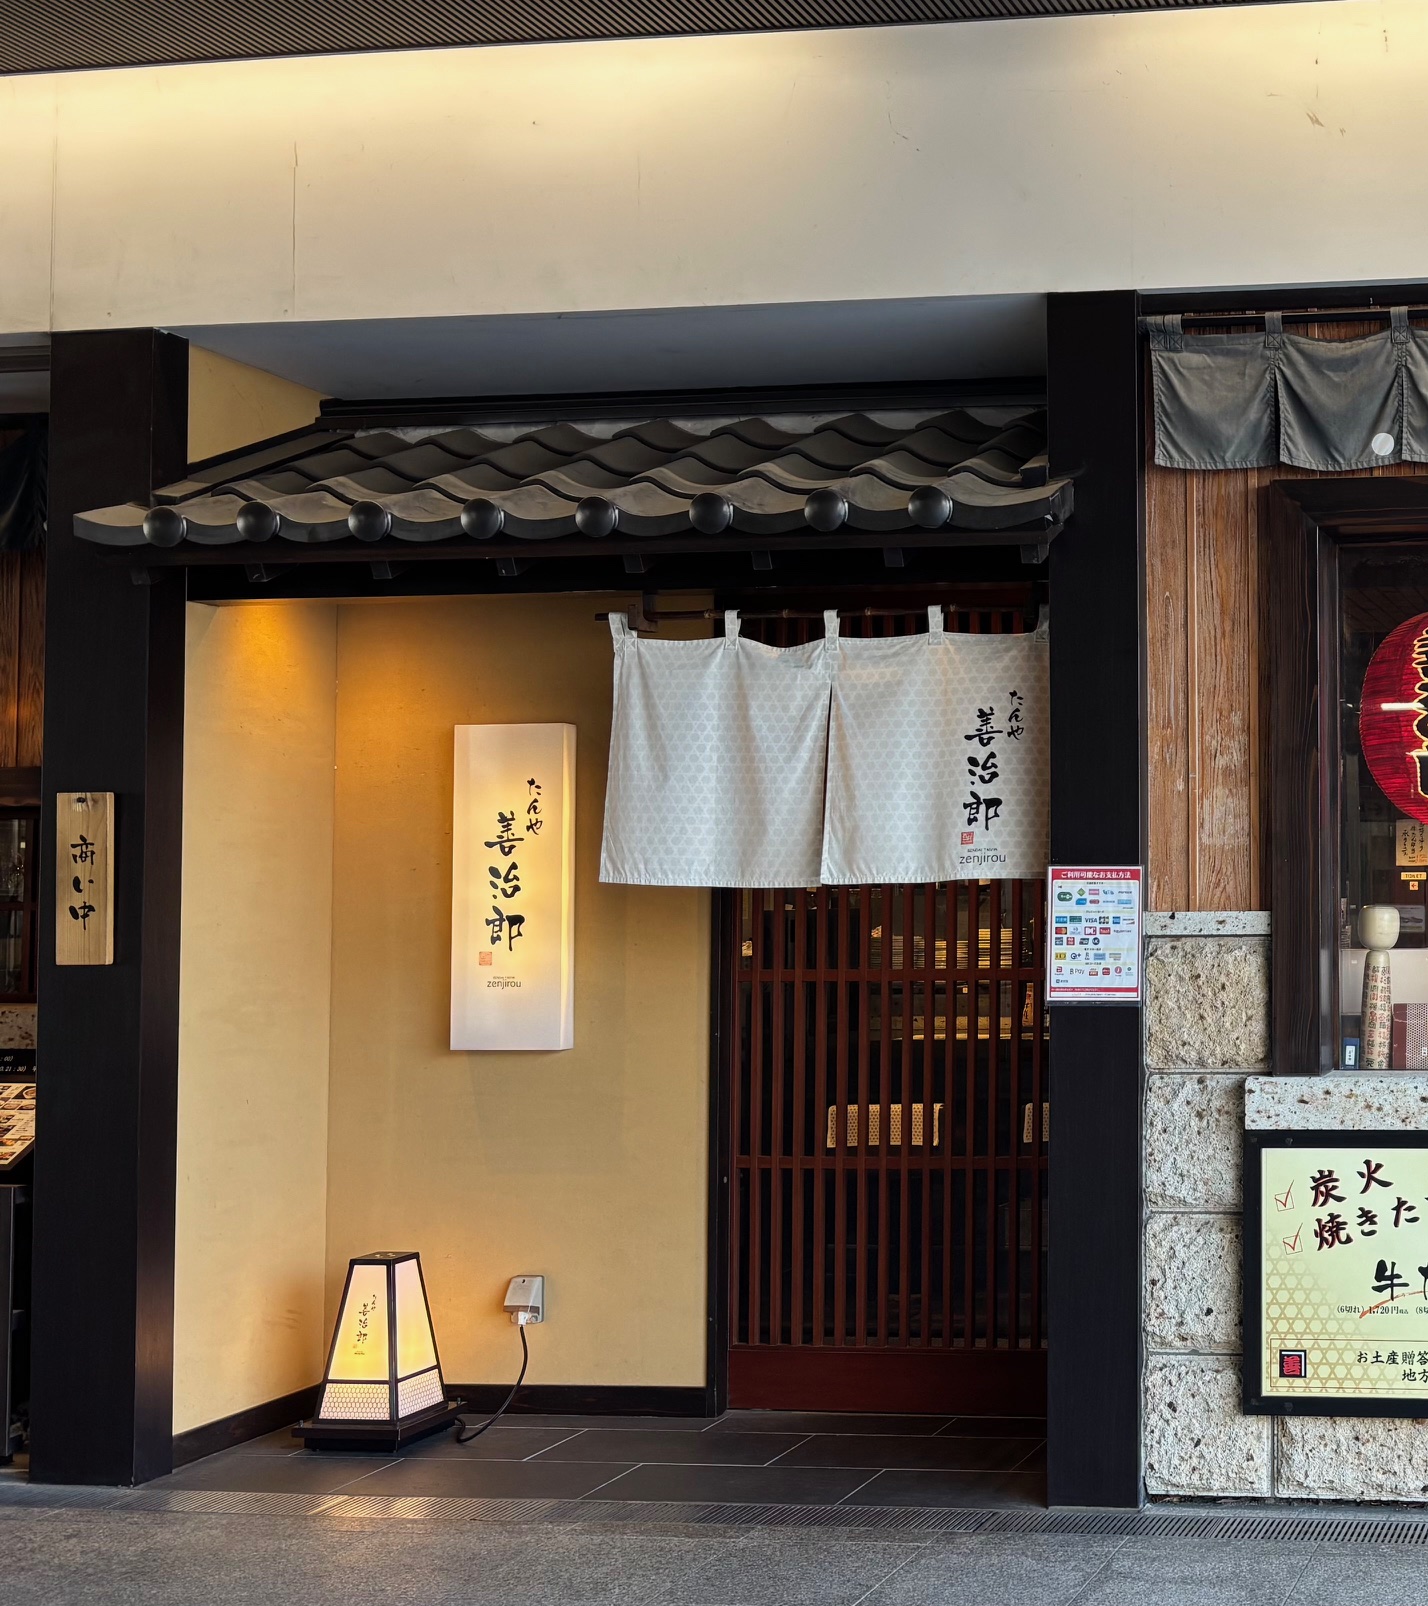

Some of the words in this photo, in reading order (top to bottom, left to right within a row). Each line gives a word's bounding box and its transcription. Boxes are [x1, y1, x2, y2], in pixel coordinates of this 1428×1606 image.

[1007, 690, 1024, 740] たんや
[963, 706, 1003, 831] 善治郎
[526, 778, 543, 835] たんや
[69, 834, 96, 930] 商い中
[484, 811, 526, 951] 善治郎
[959, 852, 1006, 866] zenjirou
[1061, 871, 1132, 879] ご利用可能なお支払方法
[486, 979, 522, 990] zenjirou
[1309, 1158, 1394, 1207] 炭火
[356, 1303, 370, 1344] 善治郎
